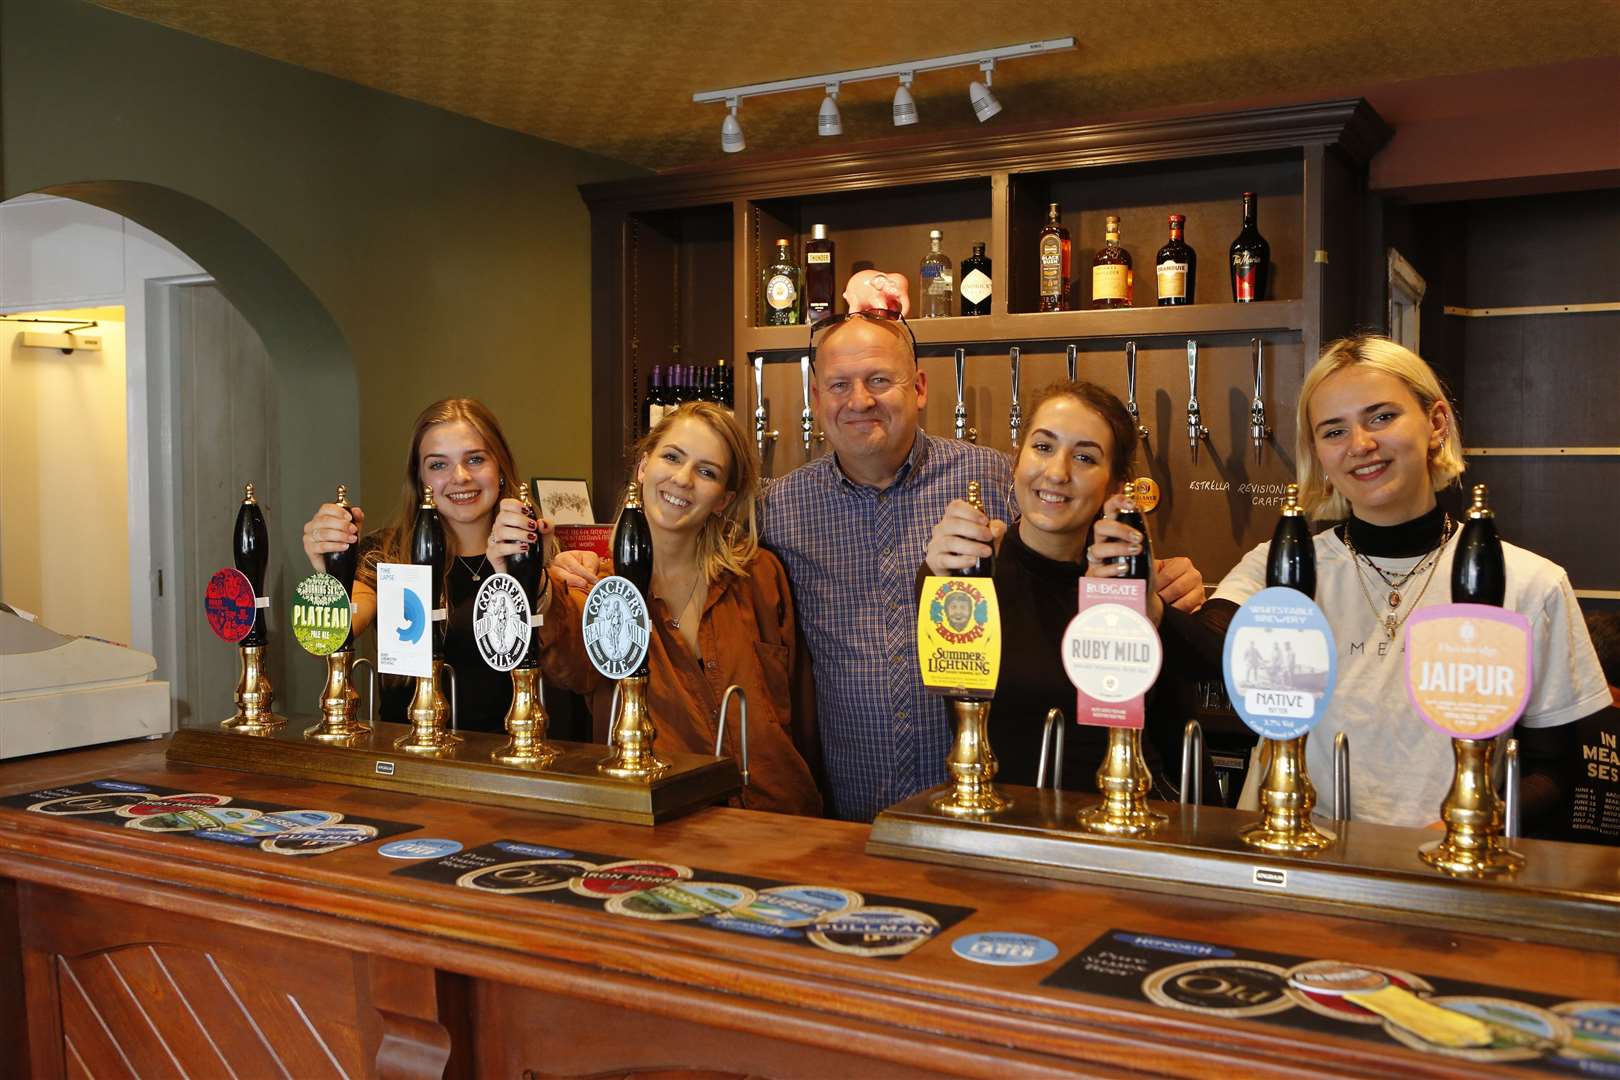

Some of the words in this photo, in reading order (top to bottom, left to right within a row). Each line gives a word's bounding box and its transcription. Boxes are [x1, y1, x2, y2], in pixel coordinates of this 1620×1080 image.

[1189, 479, 1231, 491] ESTRELLA
[1237, 482, 1288, 495] REVISIONI
[1251, 496, 1286, 507] CRAFT
[1086, 583, 1138, 595] RUDGATE
[293, 605, 348, 628] PLATEAU
[1072, 639, 1111, 660] RUBY
[1114, 641, 1151, 663] MILD
[489, 653, 515, 667] ALE
[600, 659, 630, 674] ALE
[1418, 660, 1516, 698] JAIPUR
[1256, 692, 1304, 708] NATIVE
[1601, 731, 1616, 748] IN
[1587, 762, 1619, 782] SES
[274, 833, 372, 843] PULLMAN
[581, 871, 623, 879] IRON
[815, 922, 935, 935] PULLMAN
